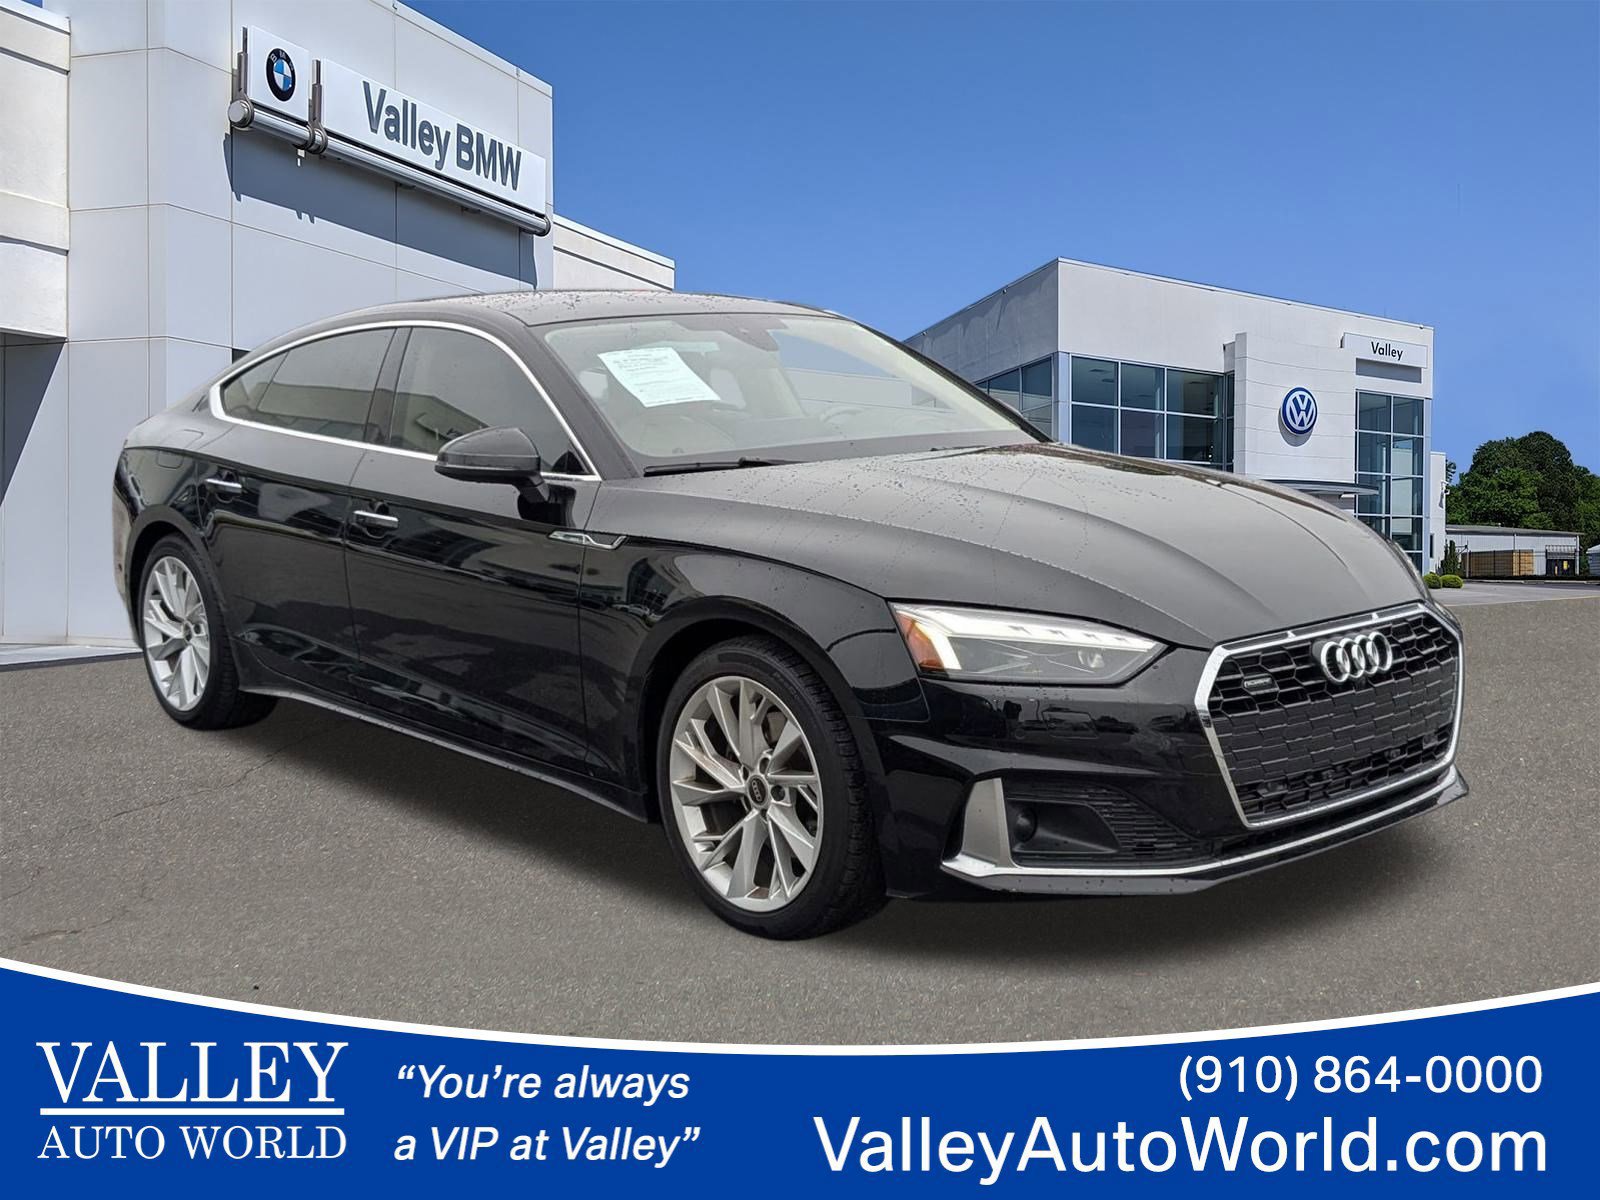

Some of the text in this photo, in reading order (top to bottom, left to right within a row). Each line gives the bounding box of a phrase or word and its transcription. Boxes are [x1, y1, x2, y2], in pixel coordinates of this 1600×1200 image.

[362, 80, 522, 191] Valley BMW
[1371, 341, 1403, 361] Valley
